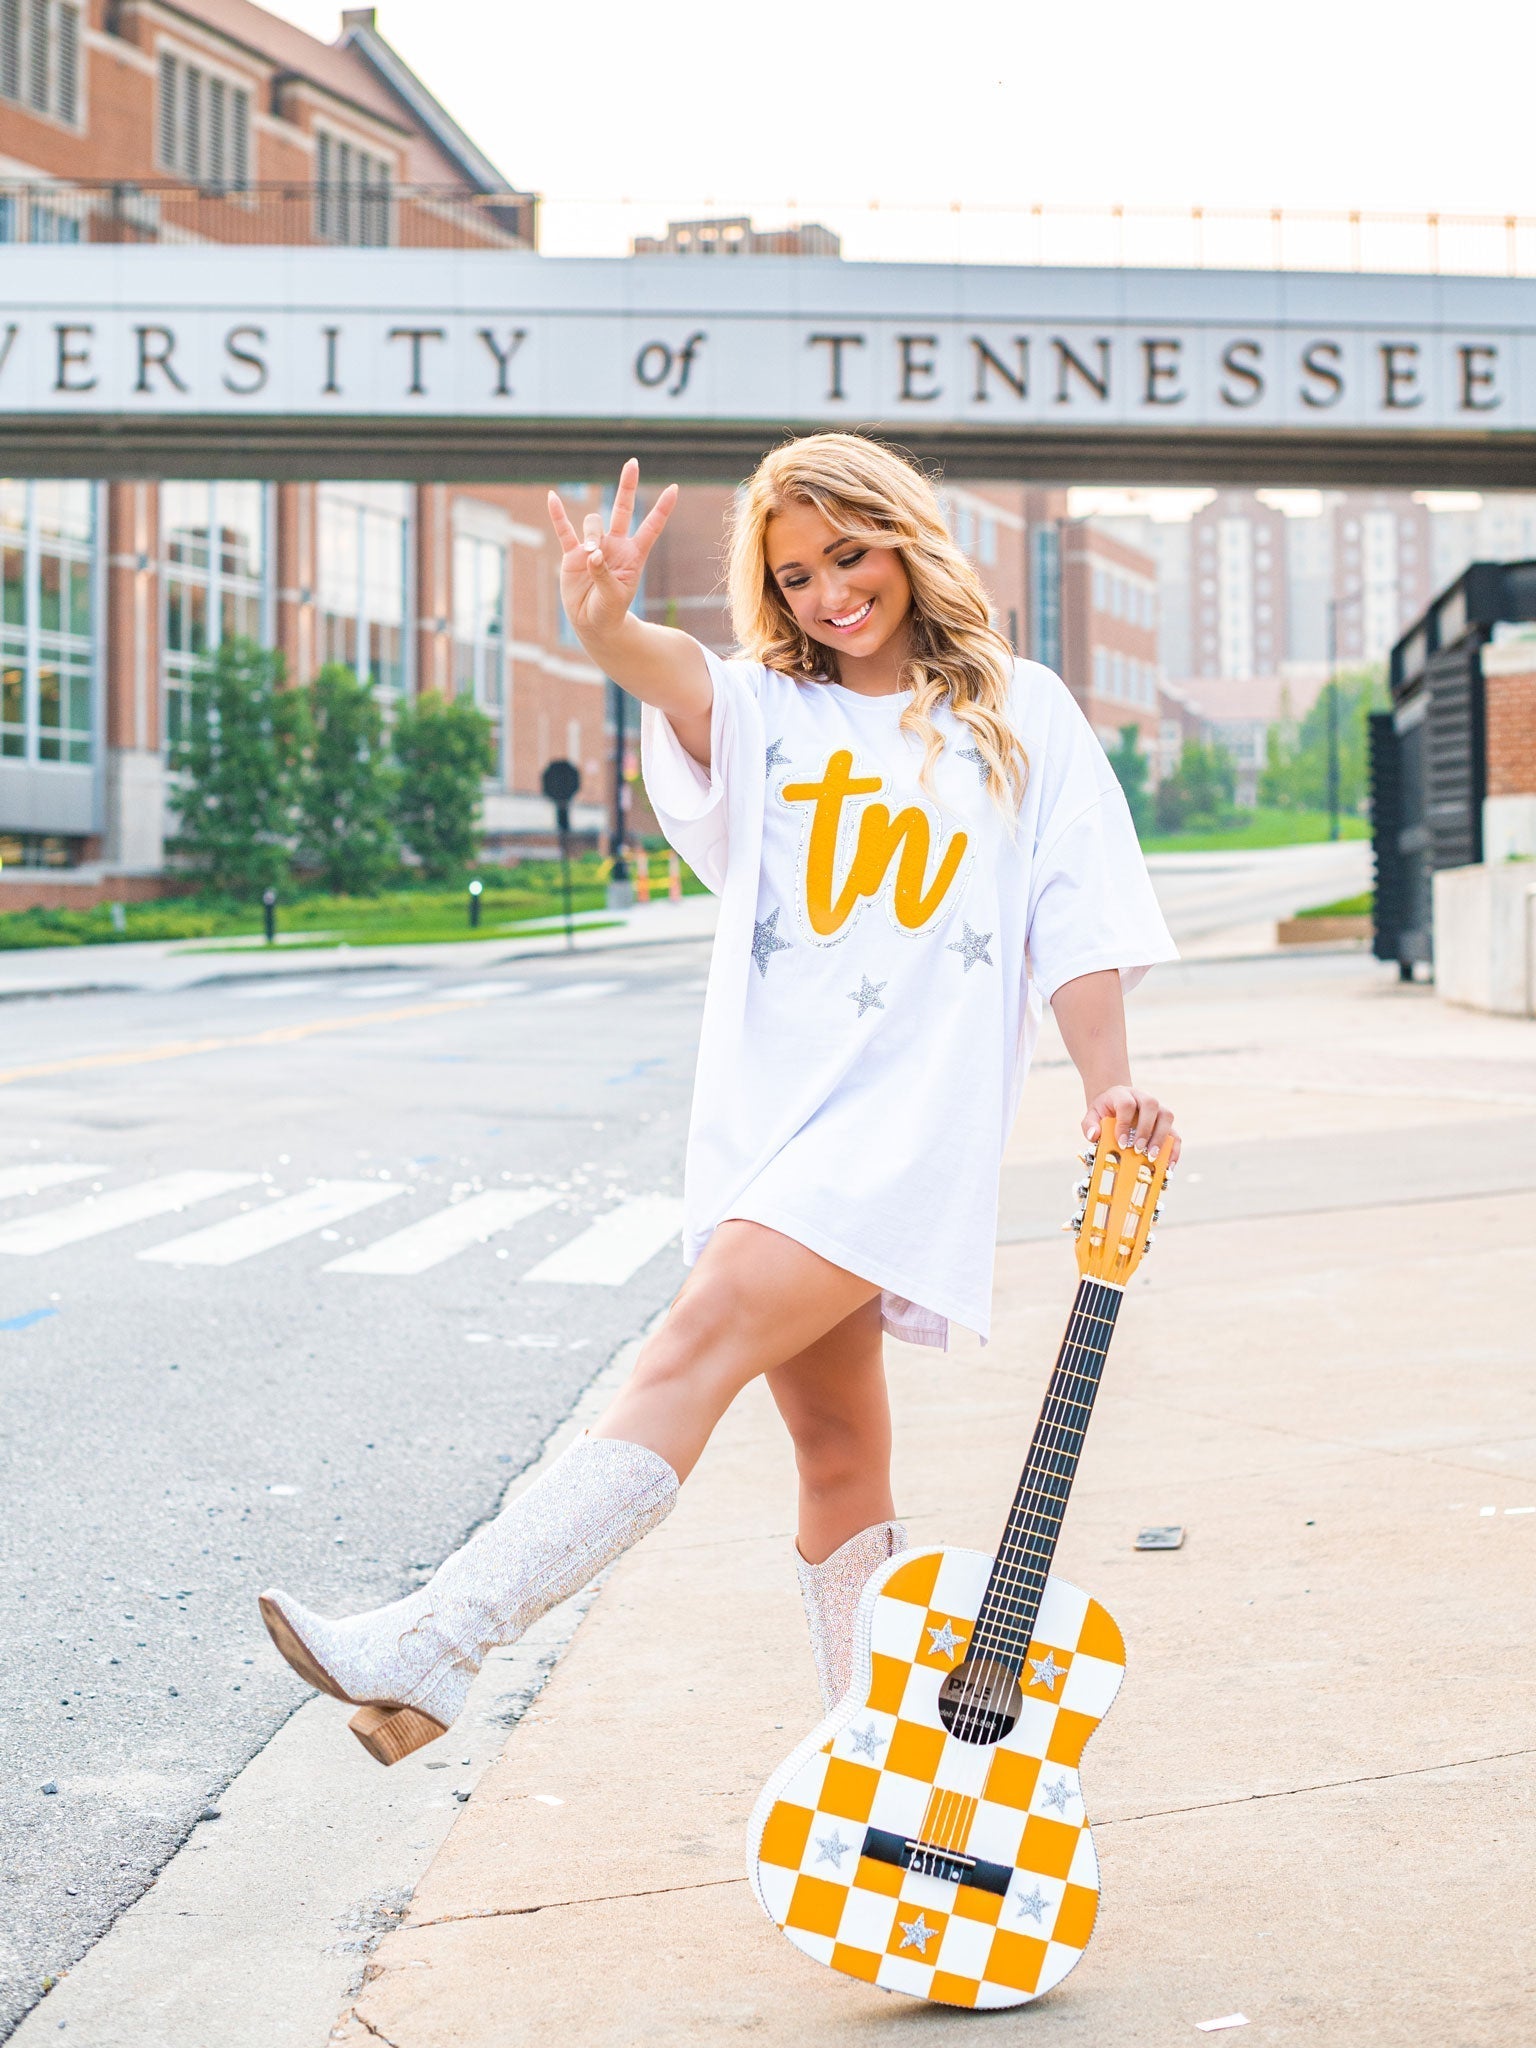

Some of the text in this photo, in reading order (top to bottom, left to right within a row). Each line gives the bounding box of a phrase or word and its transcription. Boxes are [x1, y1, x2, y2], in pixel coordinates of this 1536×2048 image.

[634, 329, 708, 397] of
[806, 332, 1504, 411] TENNESSEE
[781, 750, 968, 936] tn
